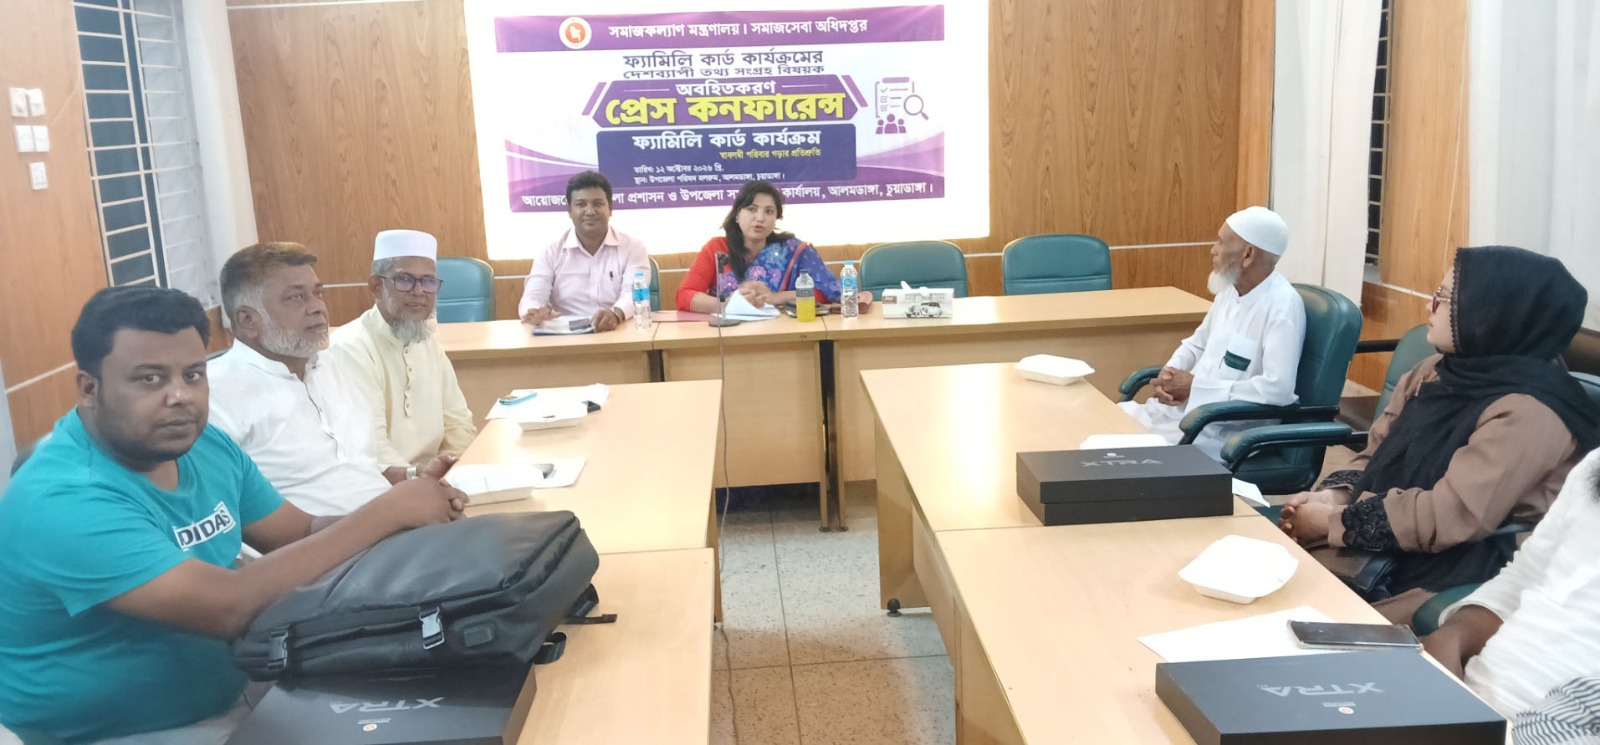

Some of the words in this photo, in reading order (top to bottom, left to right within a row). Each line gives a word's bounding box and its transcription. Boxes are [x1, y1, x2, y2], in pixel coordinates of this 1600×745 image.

[608, 24, 685, 39] সমাজকল্যাণ
[751, 20, 812, 35] সমাজসেবা
[815, 17, 868, 33] অধিদপ্তর
[622, 50, 693, 68] ফ্যামিলি
[700, 49, 735, 66] কার্ড
[741, 48, 823, 65] কার্যক্রমের
[623, 66, 694, 79] দেশব্যাপী
[700, 68, 729, 78] তথ্য
[734, 67, 773, 76] সংগ্রহ
[778, 64, 825, 75] বিষয়ক
[675, 79, 777, 96] অবহিতকরণ
[605, 97, 678, 125] প্রেস
[685, 93, 846, 122] কনফারেন্স
[631, 130, 703, 150] ফ্যামিলি
[708, 129, 746, 148] কার্ড
[752, 127, 822, 146] কার্যক্রম
[627, 190, 664, 204] প্রশাসন
[669, 190, 677, 202] ও
[679, 187, 724, 202] উপজেলা
[1260, 682, 1385, 697] XTRA
[329, 697, 445, 713] XTRA
